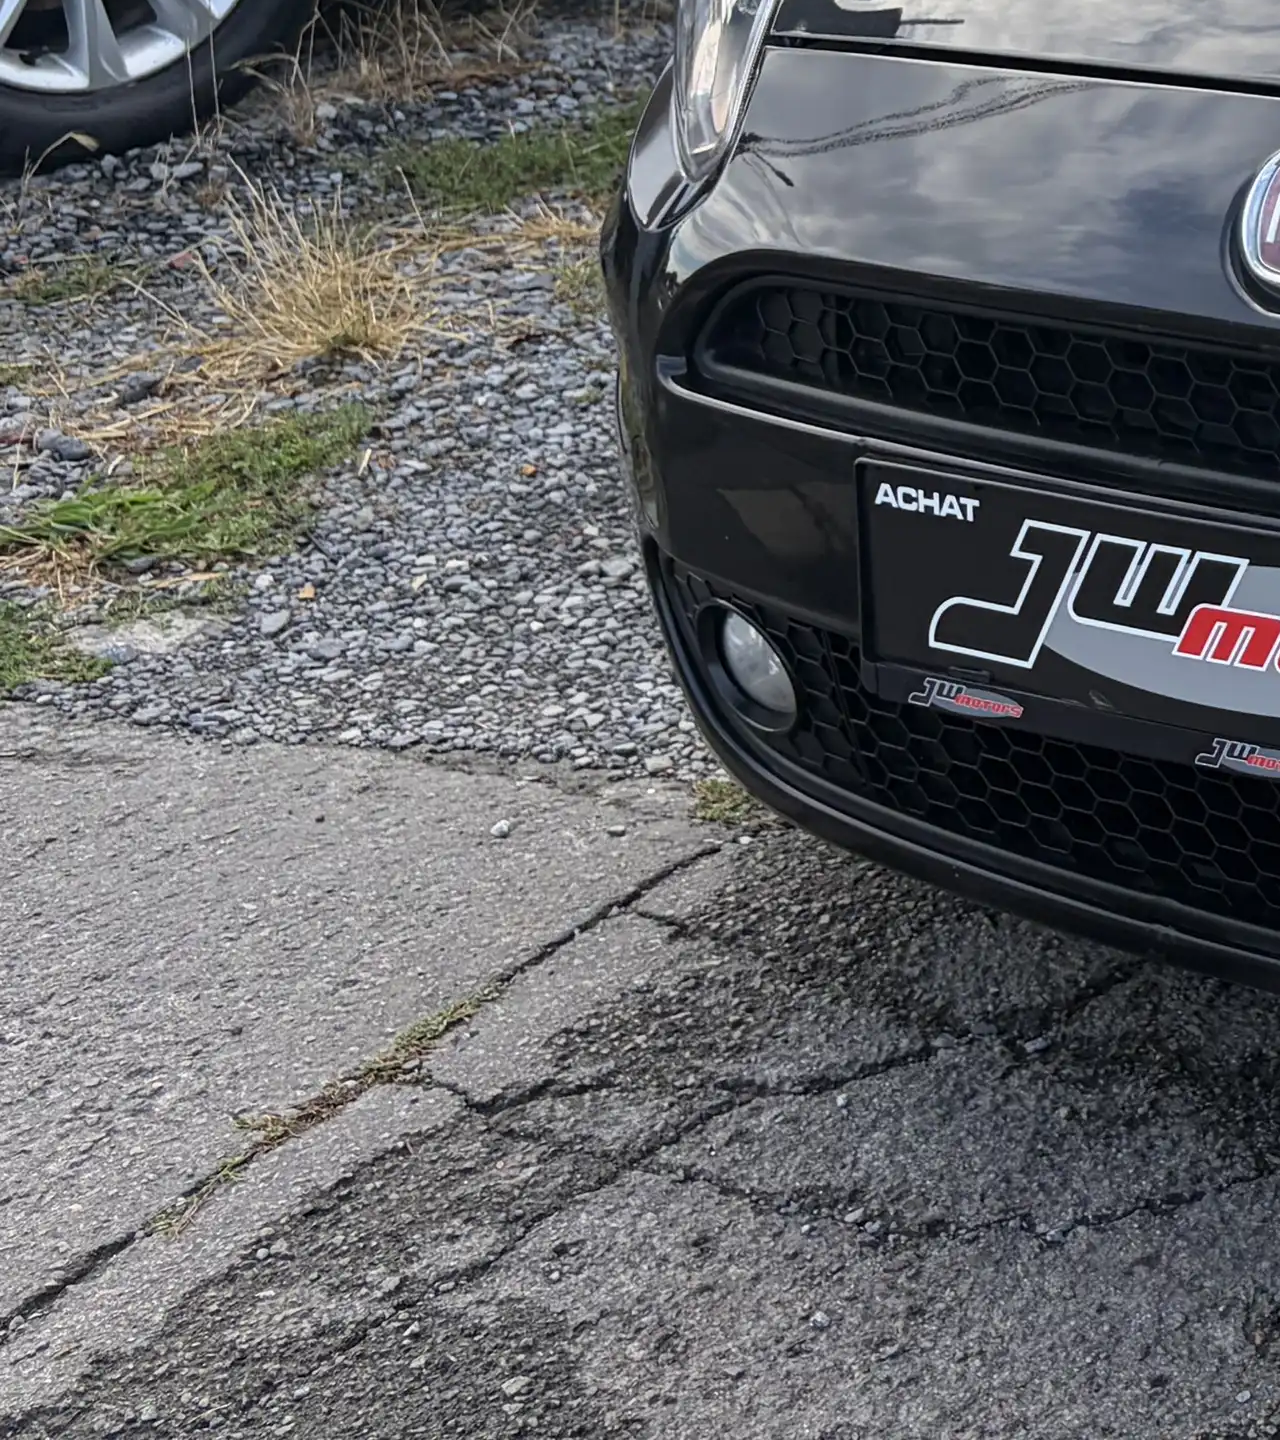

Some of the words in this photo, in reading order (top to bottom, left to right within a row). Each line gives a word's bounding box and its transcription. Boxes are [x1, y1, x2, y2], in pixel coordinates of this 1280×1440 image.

[874, 482, 980, 522] ACHAT
[928, 518, 1250, 669] JW
[908, 677, 967, 707] JW
[1195, 738, 1260, 768] JW
